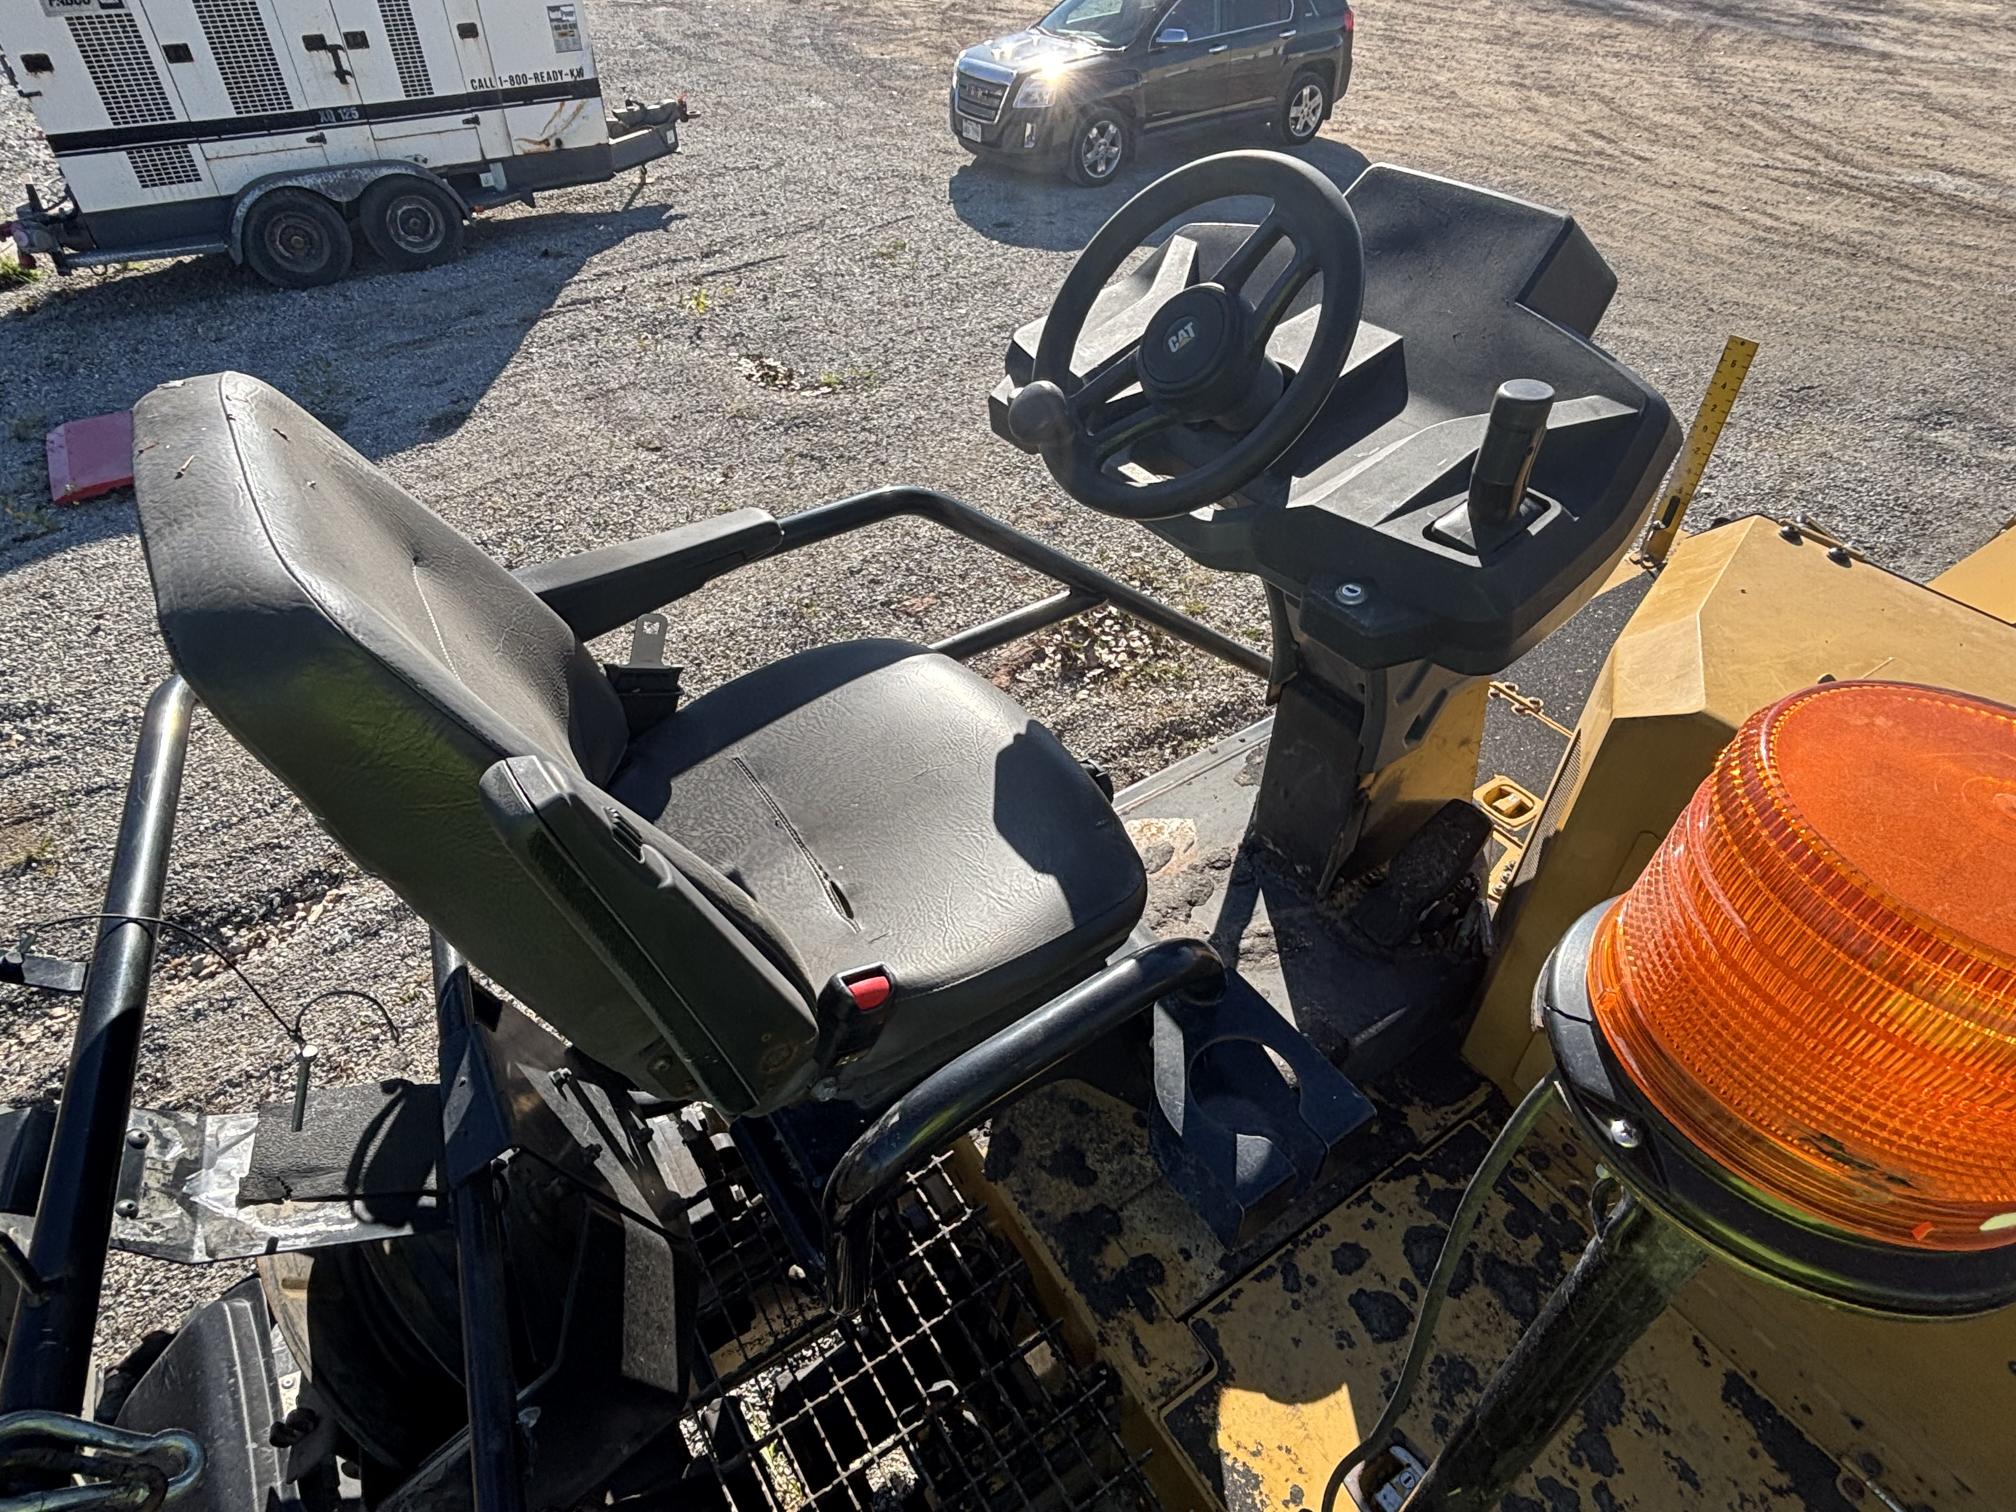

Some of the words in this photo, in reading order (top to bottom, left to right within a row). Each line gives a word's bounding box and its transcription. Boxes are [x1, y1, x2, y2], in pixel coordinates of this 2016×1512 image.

[470, 76, 496, 91] CALL
[337, 106, 360, 121] 125
[1167, 321, 1195, 353] CAT
[1710, 403, 1718, 412] 2
